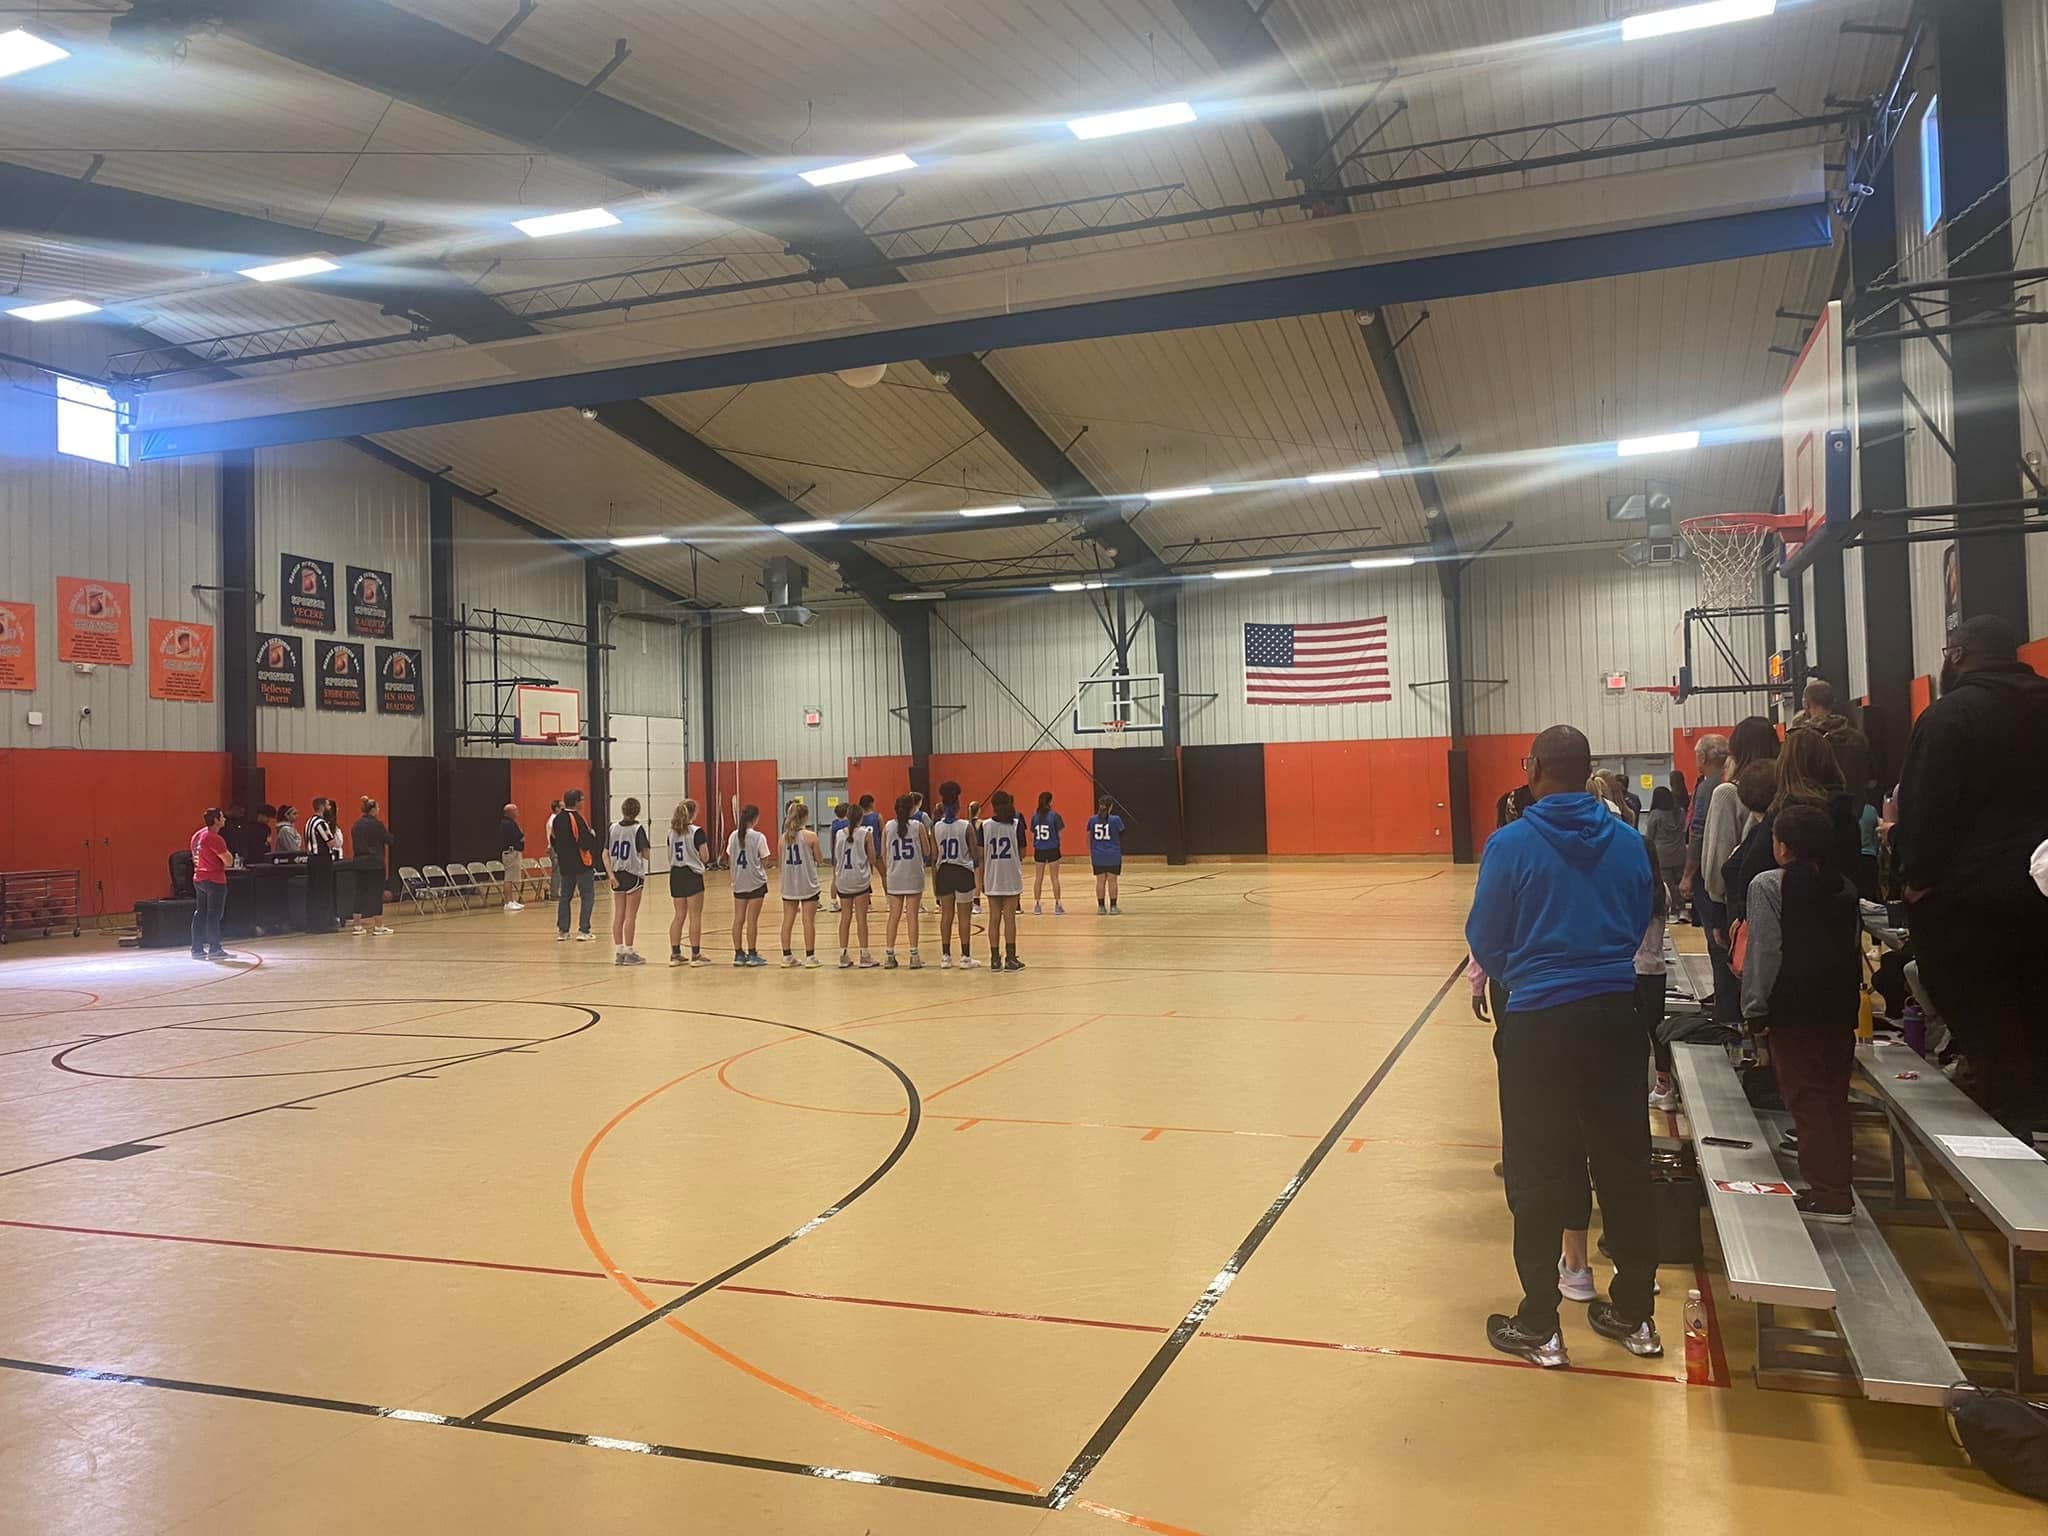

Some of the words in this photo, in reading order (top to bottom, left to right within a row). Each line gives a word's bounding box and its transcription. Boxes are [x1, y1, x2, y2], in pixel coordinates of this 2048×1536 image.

[261, 683, 293, 695] Bellevue
[264, 694, 289, 704] Tavern
[1034, 824, 1050, 840] 15
[1094, 823, 1111, 840] 51
[611, 840, 631, 860] 40
[674, 841, 683, 861] 5
[786, 844, 802, 865] 11
[892, 838, 915, 860] 15
[940, 838, 959, 859] 10
[989, 837, 1012, 859] 12
[736, 849, 747, 869] 4
[844, 848, 853, 869] 1
